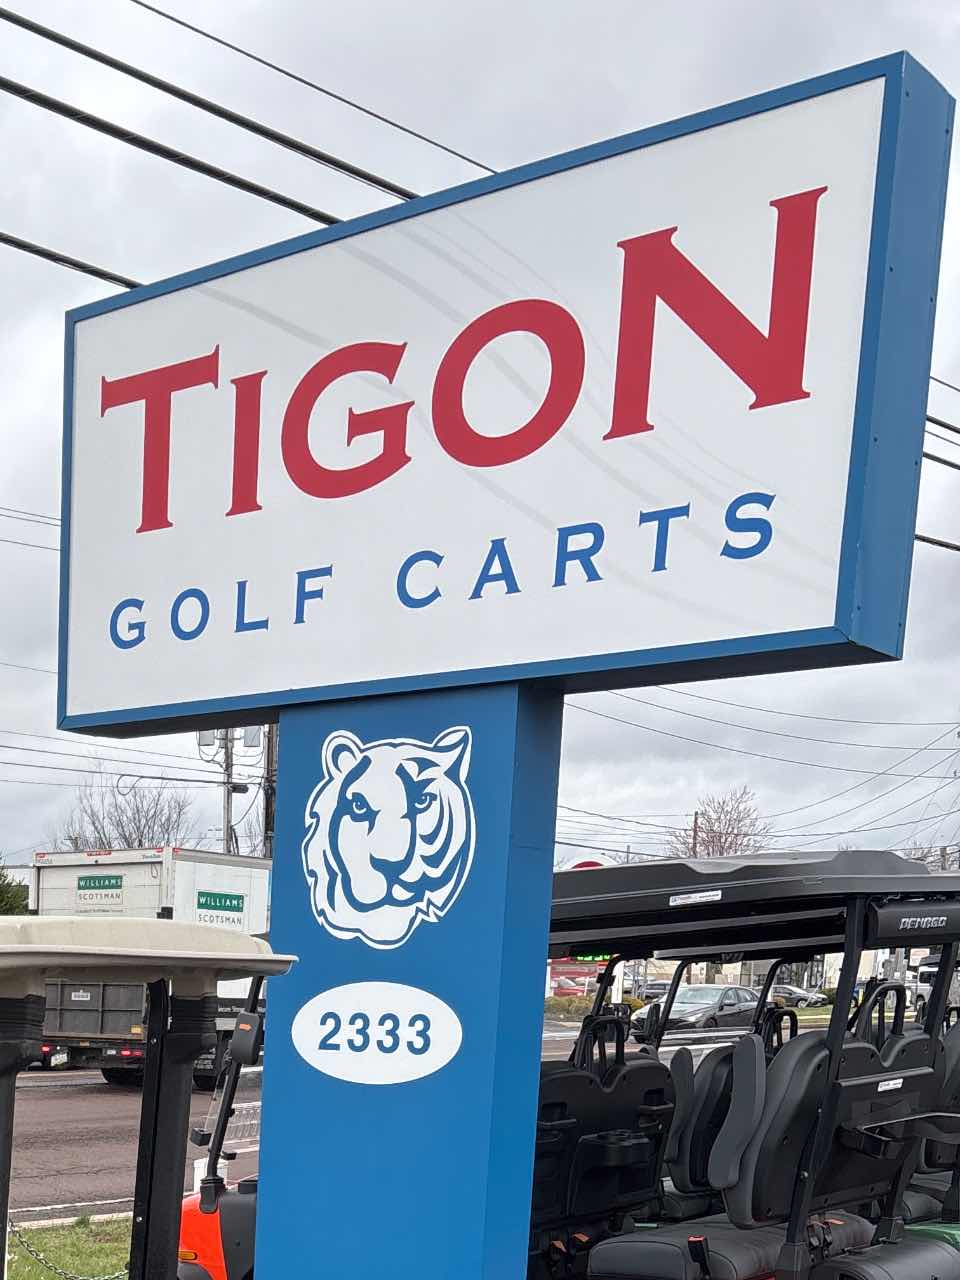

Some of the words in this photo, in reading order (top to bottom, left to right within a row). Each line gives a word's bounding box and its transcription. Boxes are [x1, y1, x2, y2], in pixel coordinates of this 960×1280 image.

[101, 186, 828, 533] TIGON
[110, 566, 334, 650] GOLF
[396, 492, 776, 609] CARTS
[80, 879, 121, 887] WILLIAMS
[199, 896, 242, 908] WILLIAMS
[199, 914, 242, 925] SCOTSMAN
[318, 1011, 431, 1055] 2333
